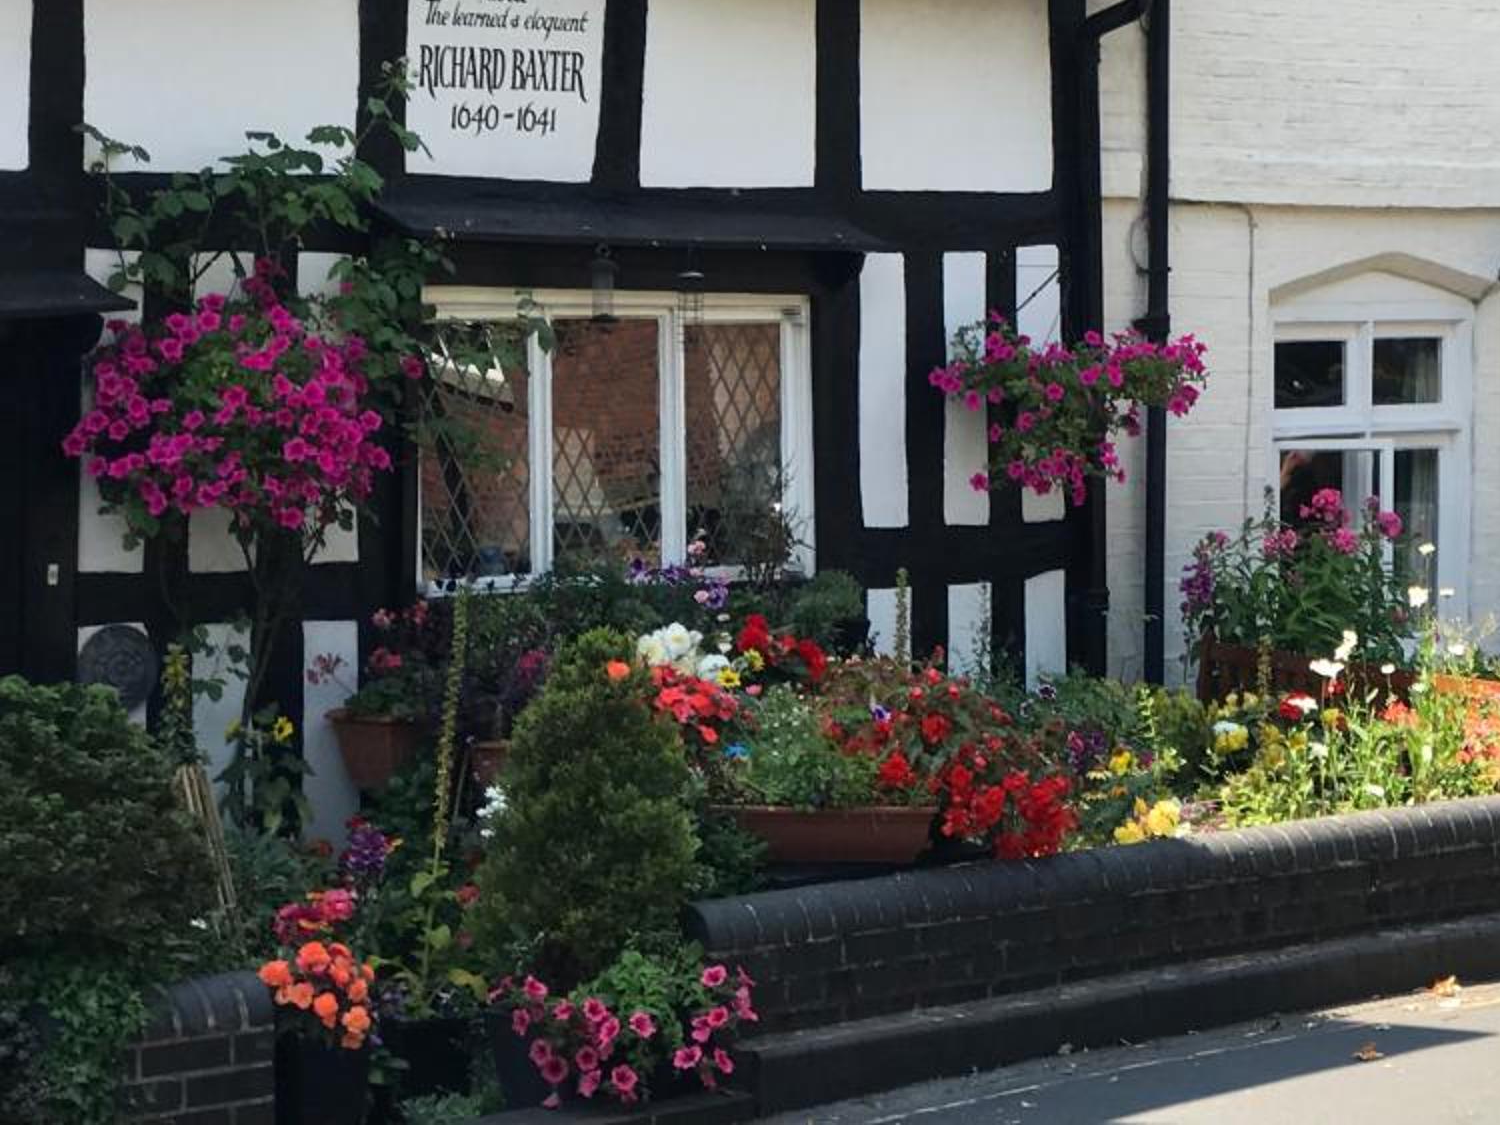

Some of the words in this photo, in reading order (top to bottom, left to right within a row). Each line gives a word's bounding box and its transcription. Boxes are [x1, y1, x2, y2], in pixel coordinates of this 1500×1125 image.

[451, 1, 511, 29] learned
[523, 8, 589, 42] eloquent
[418, 44, 506, 100] RICHARD
[510, 49, 588, 104] BAXTER
